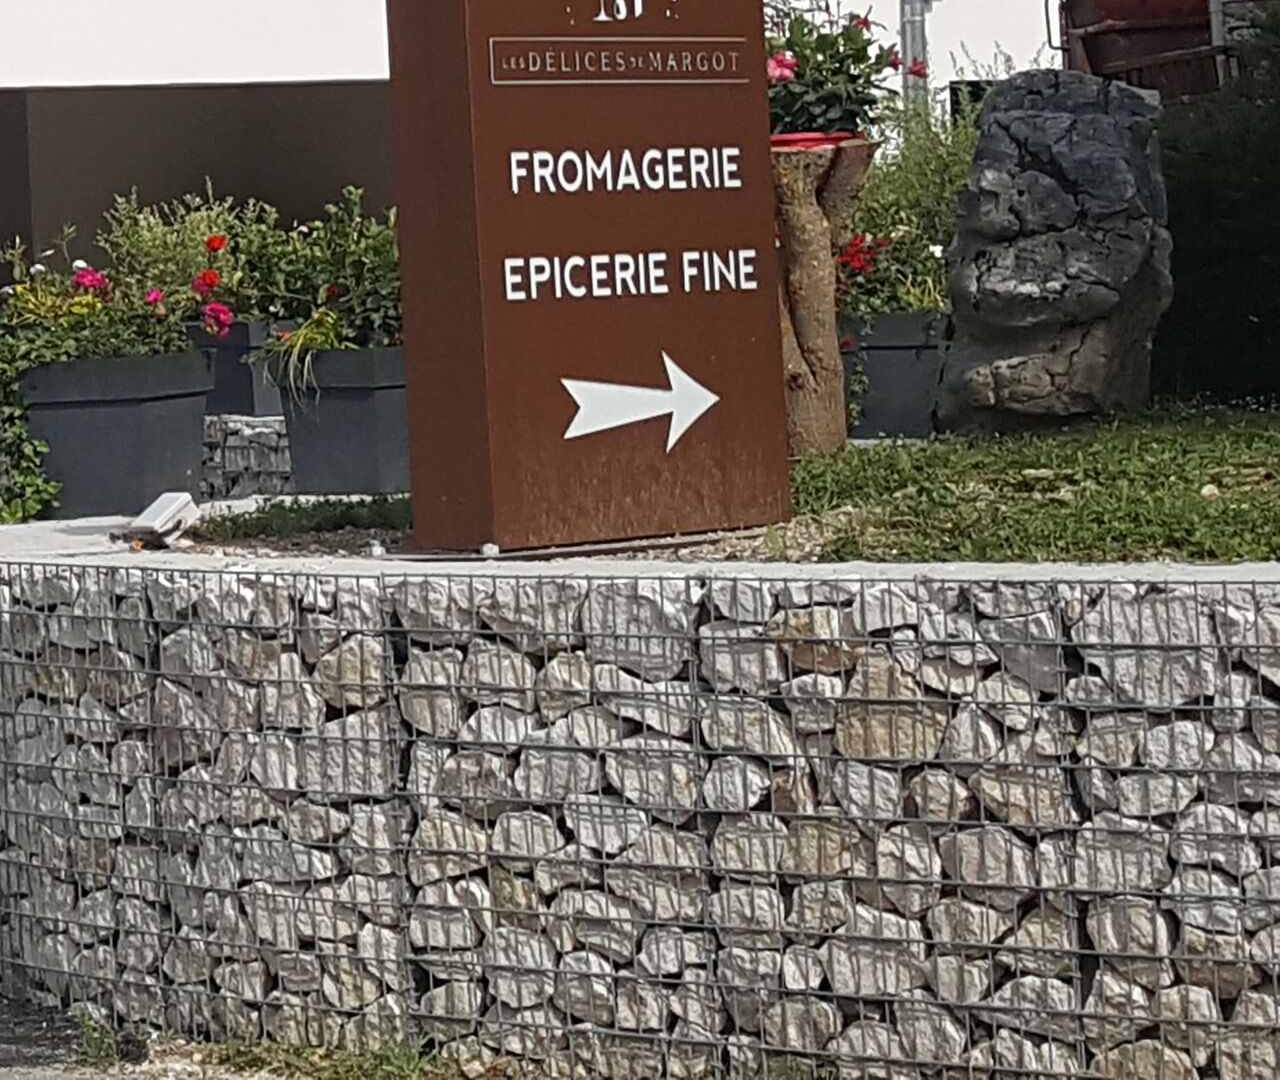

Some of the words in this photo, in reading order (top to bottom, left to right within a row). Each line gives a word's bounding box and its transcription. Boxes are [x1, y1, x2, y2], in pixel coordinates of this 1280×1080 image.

[528, 46, 627, 73] DÉLICES
[648, 51, 741, 73] MARGOT
[510, 147, 743, 195] FROMAGERIE
[504, 252, 670, 301] EPICERIE
[682, 249, 759, 293] FINE
